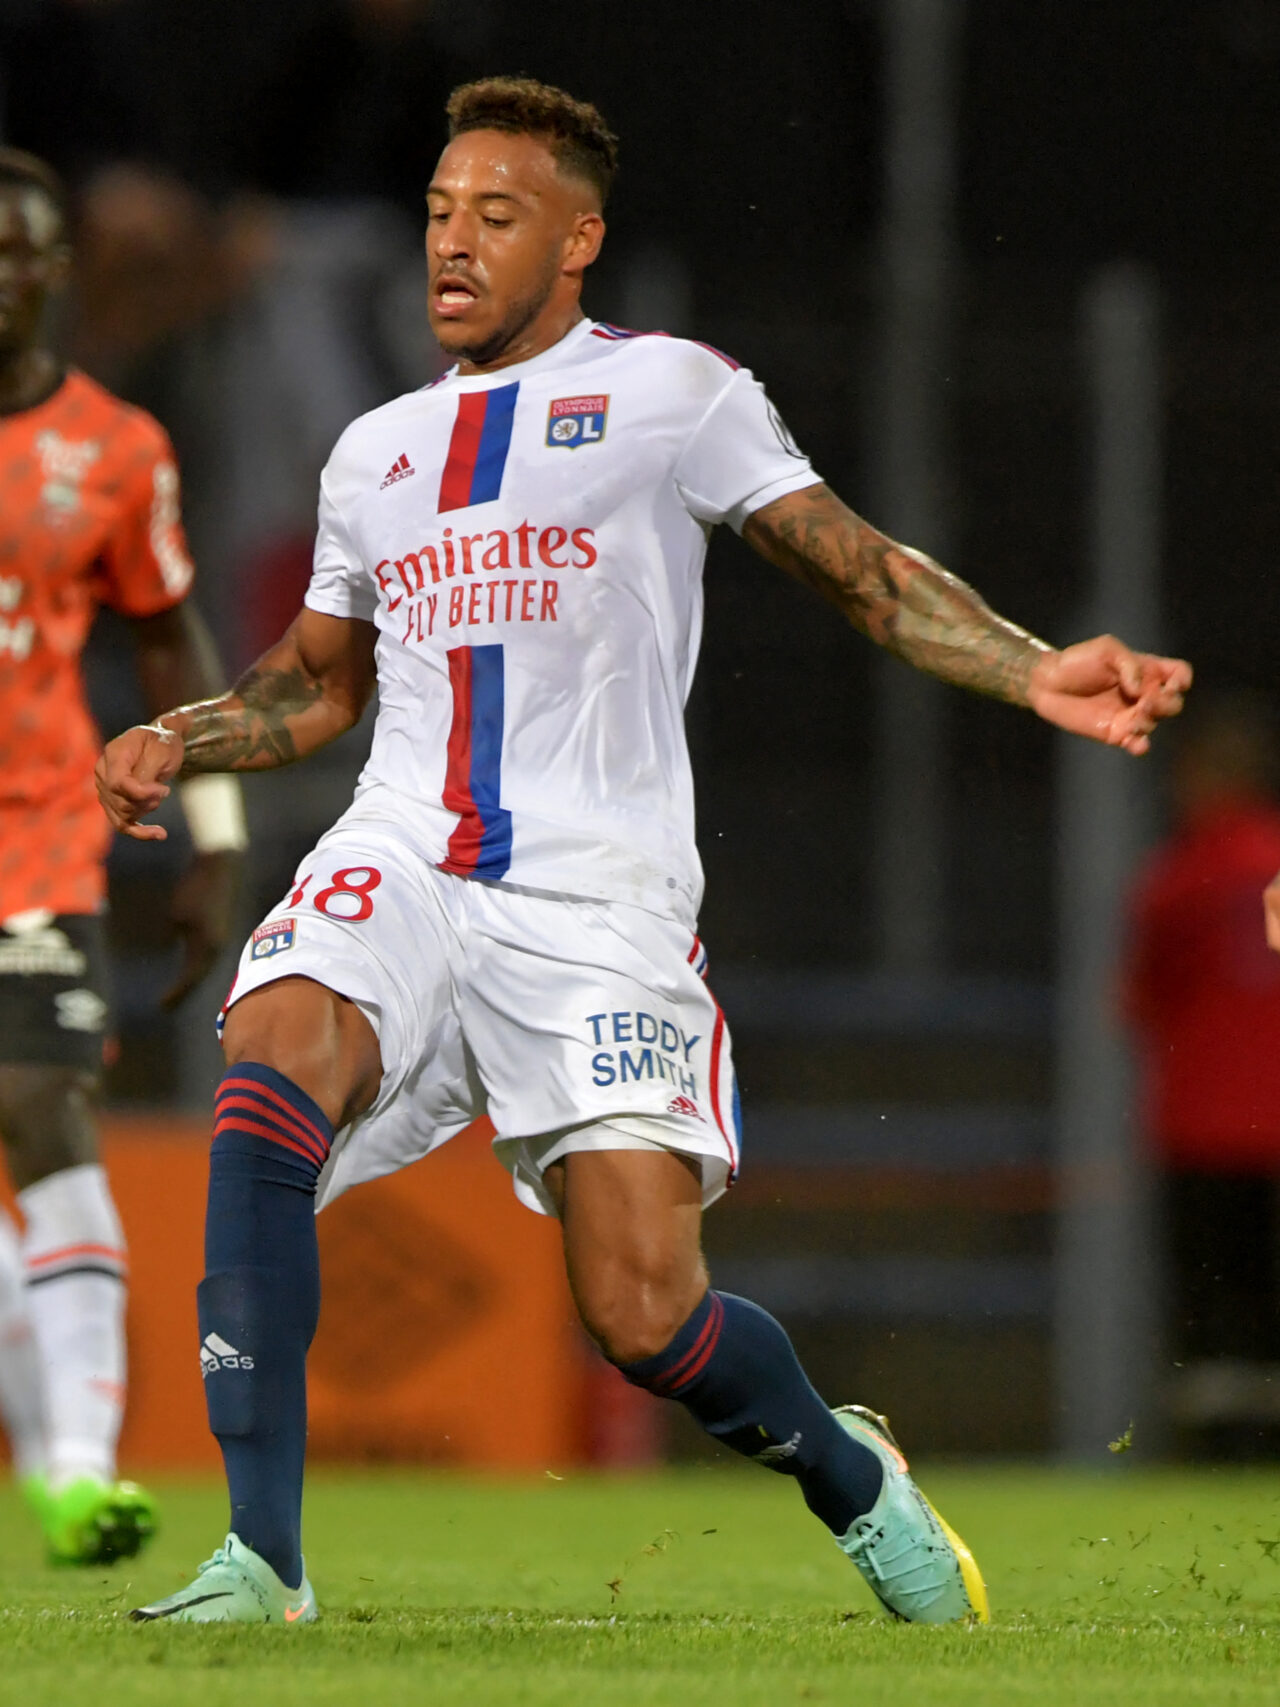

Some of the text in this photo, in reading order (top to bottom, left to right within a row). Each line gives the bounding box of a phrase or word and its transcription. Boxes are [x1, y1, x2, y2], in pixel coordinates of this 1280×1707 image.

[552, 403, 605, 416] LYONNAIS
[374, 518, 598, 613] Emirates
[402, 579, 559, 646] FLY BETTER
[585, 1010, 702, 1064] TEDDY
[591, 1048, 698, 1101] SMITH
